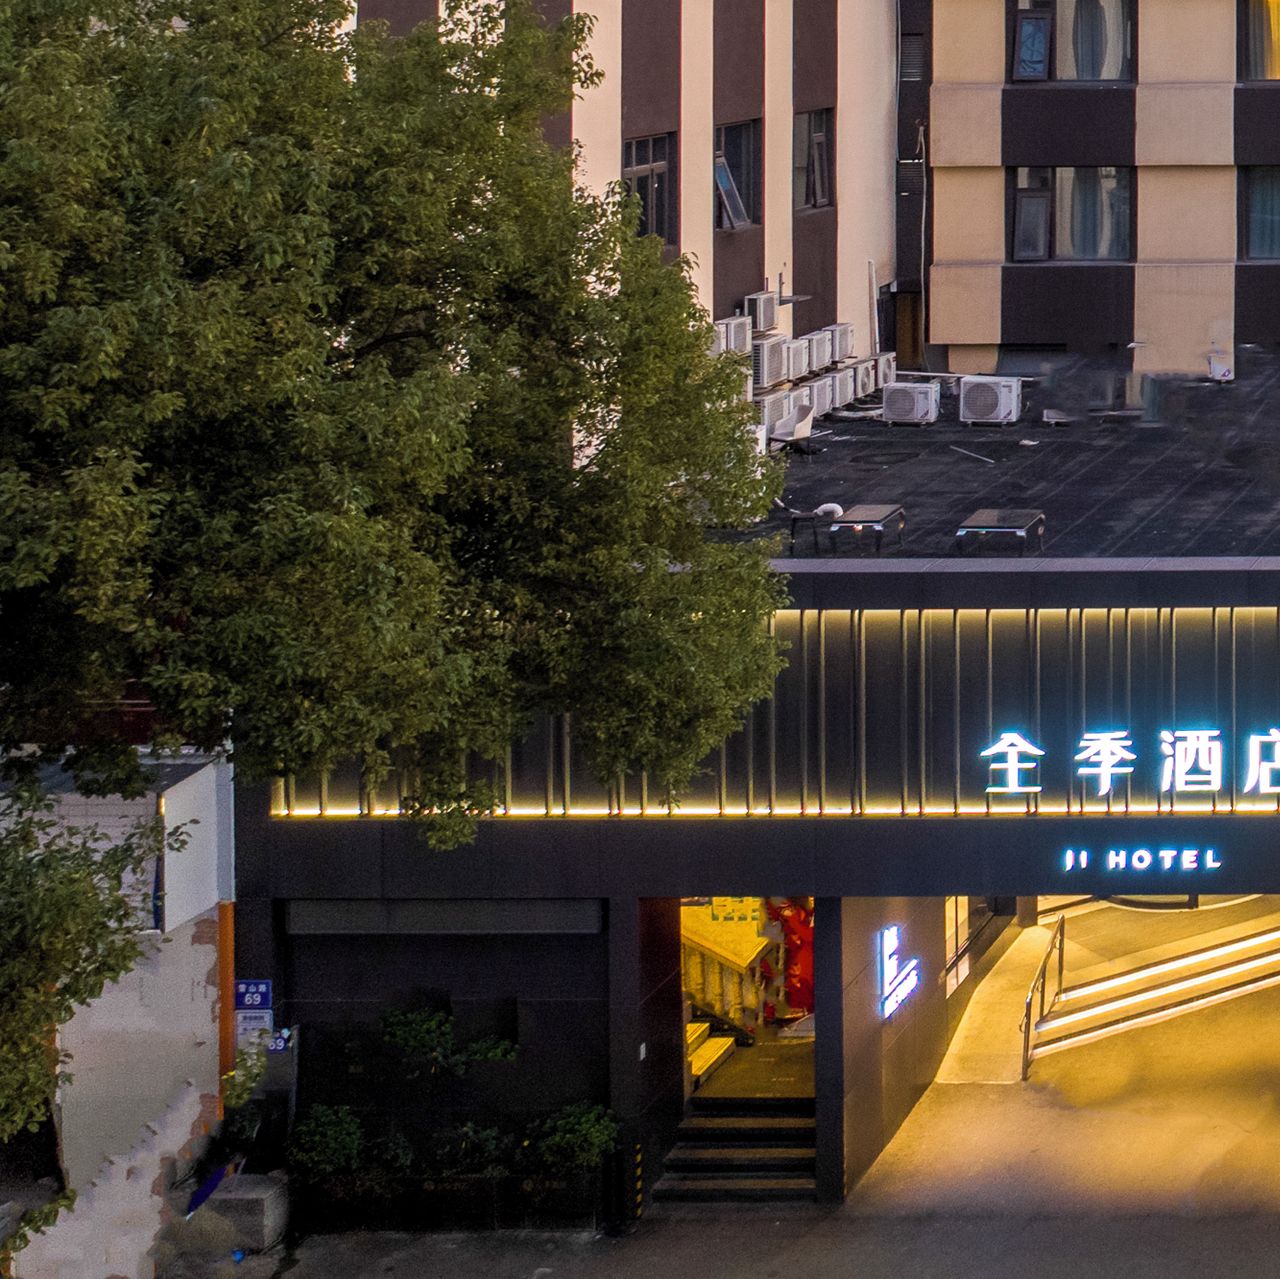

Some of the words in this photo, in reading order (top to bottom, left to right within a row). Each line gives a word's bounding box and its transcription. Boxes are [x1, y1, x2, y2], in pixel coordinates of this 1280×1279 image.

[1065, 849, 1088, 871] JI
[1107, 848, 1223, 870] HOTEL
[244, 993, 262, 1005] 69
